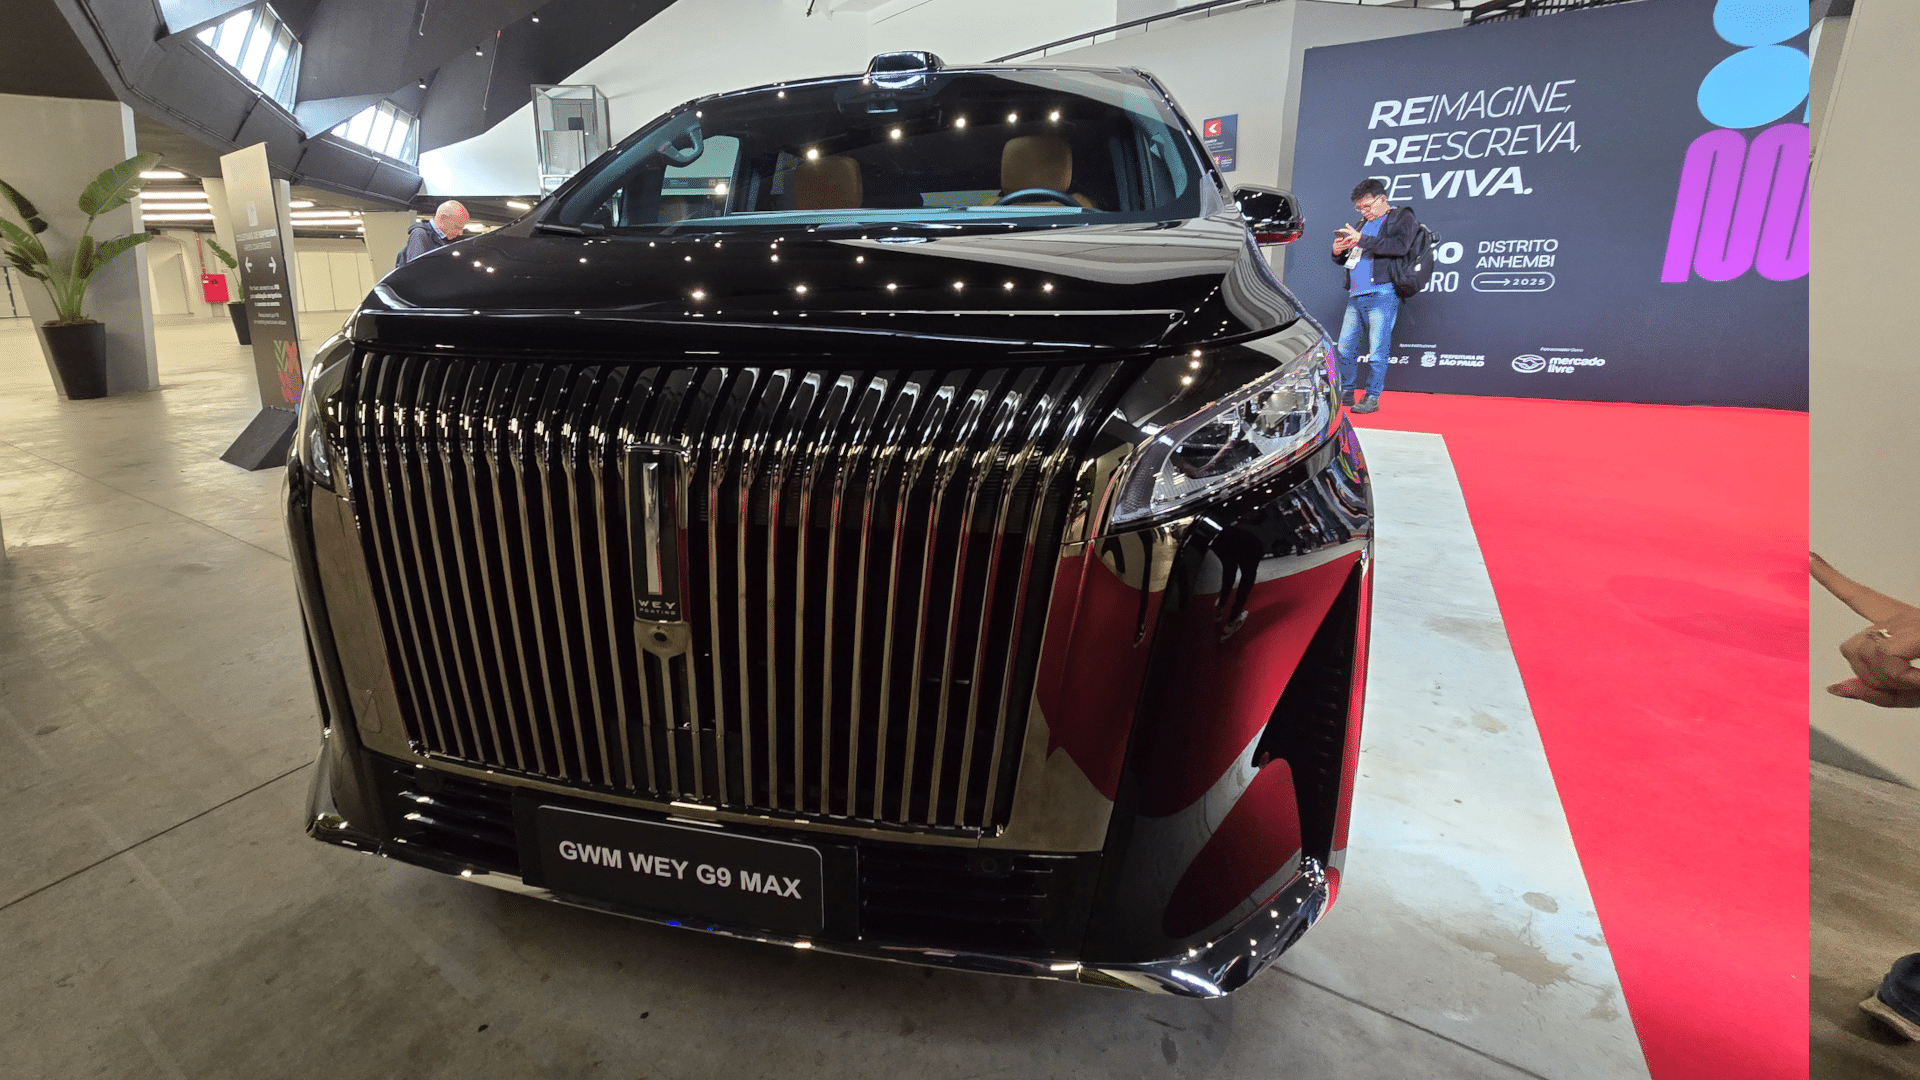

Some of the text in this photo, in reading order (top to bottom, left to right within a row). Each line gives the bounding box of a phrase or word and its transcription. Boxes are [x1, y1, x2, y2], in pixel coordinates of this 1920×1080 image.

[1368, 79, 1576, 129] REIMAGINE,
[1364, 121, 1581, 166] REESCREVA,
[1477, 238, 1559, 254] DISTRITO
[1475, 254, 1556, 269] ANHEMBI
[1512, 278, 1547, 286] 2025
[1547, 363, 1575, 374] livre
[1549, 356, 1606, 367] mercado
[638, 599, 676, 609] WEY
[559, 840, 802, 899] GWM WEY G9 MAX
